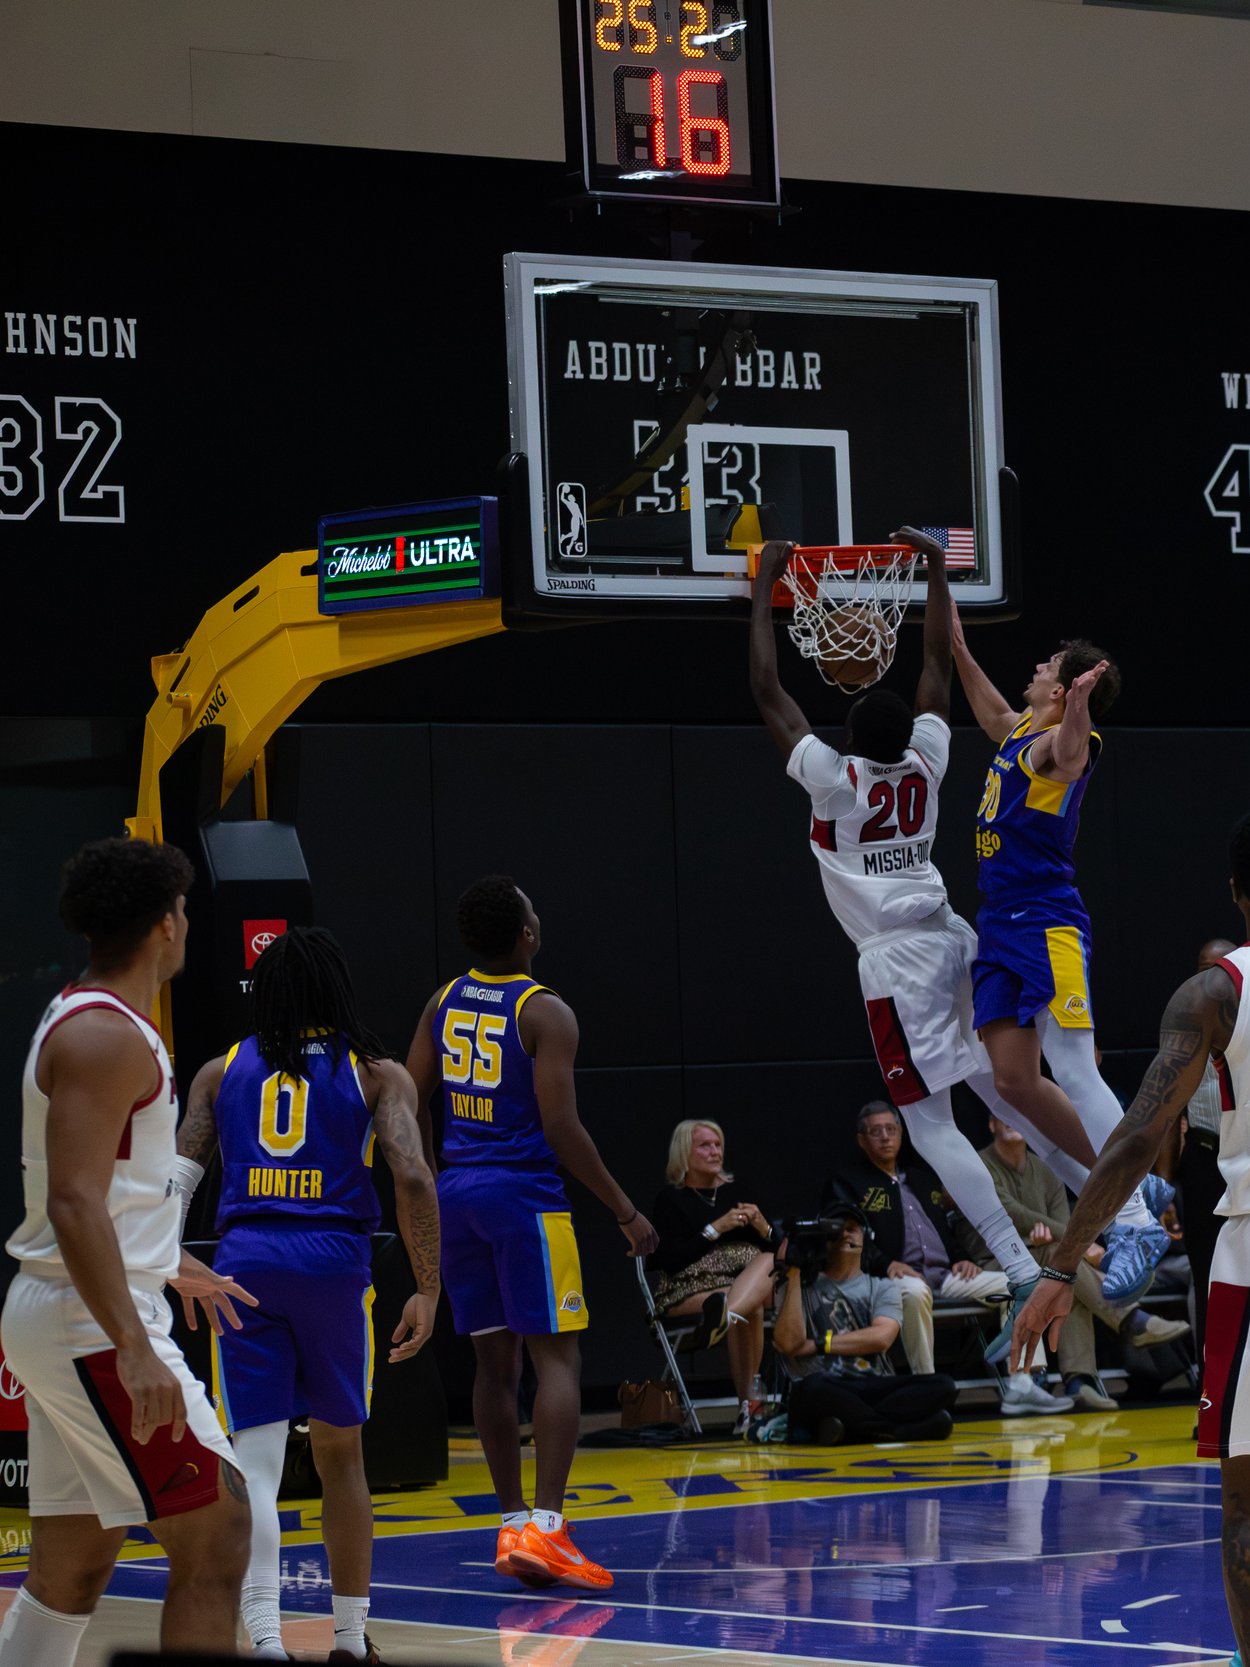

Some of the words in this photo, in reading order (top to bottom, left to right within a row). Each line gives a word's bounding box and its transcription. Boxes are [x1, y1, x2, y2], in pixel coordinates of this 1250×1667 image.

[650, 69, 731, 176] 16
[4, 311, 138, 360] HNSON
[0, 393, 126, 524] 32
[328, 545, 391, 578] Michelob
[410, 535, 476, 567] ULTRA
[547, 578, 596, 592] SPALDING
[859, 771, 928, 844] 20
[442, 1008, 507, 1089] 55
[258, 1070, 310, 1157] 0
[451, 1091, 493, 1123] TAYLOR
[248, 1167, 323, 1199] HUNTER
